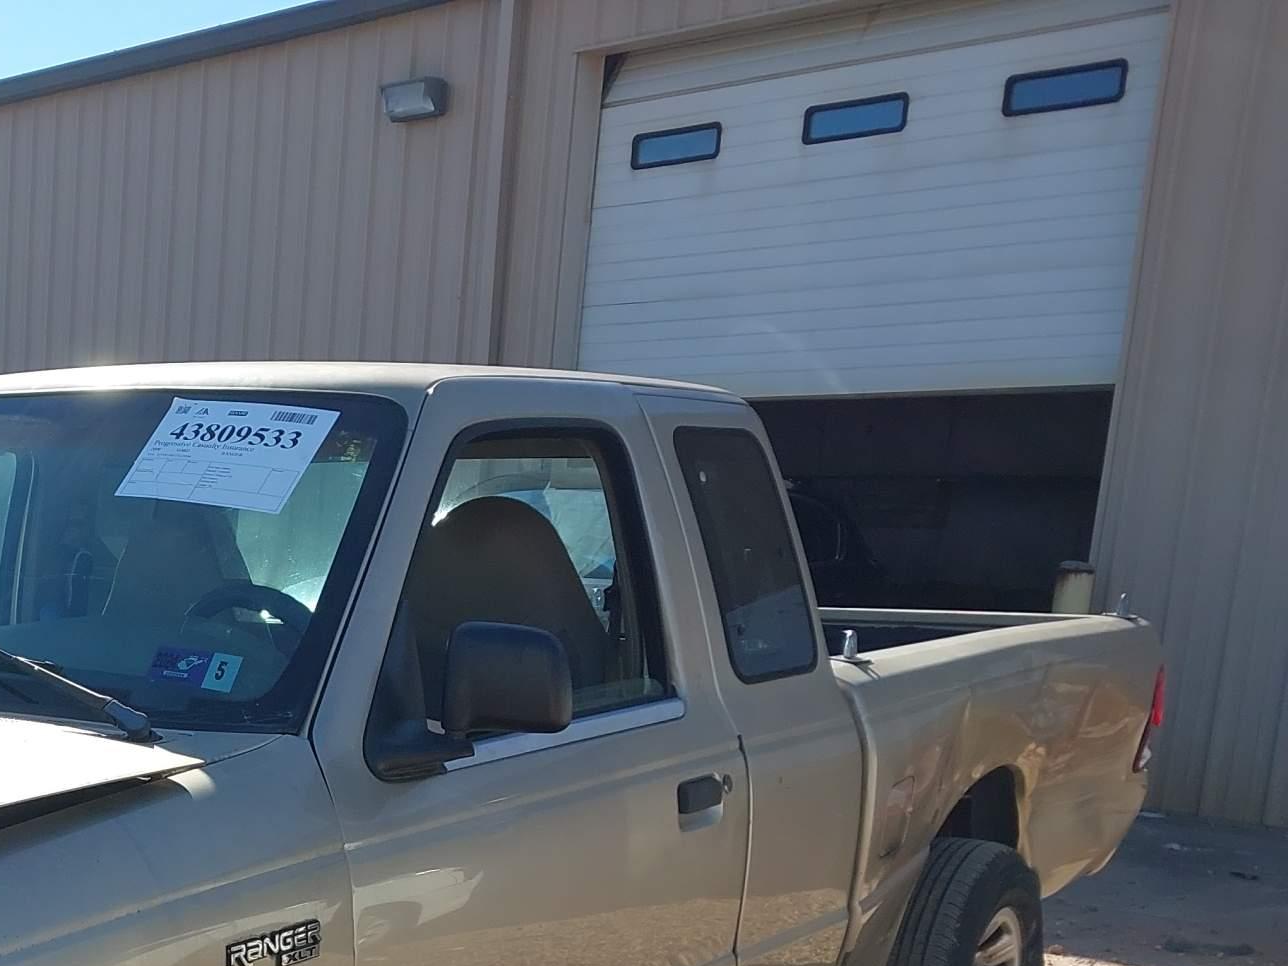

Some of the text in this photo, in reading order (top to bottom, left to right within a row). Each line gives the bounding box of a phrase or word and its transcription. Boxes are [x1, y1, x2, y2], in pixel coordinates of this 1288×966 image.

[170, 422, 303, 450] 43809533
[192, 441, 221, 450] Casualty
[222, 443, 255, 452] Insurance
[214, 660, 229, 681] 5
[286, 945, 318, 965] XLT
